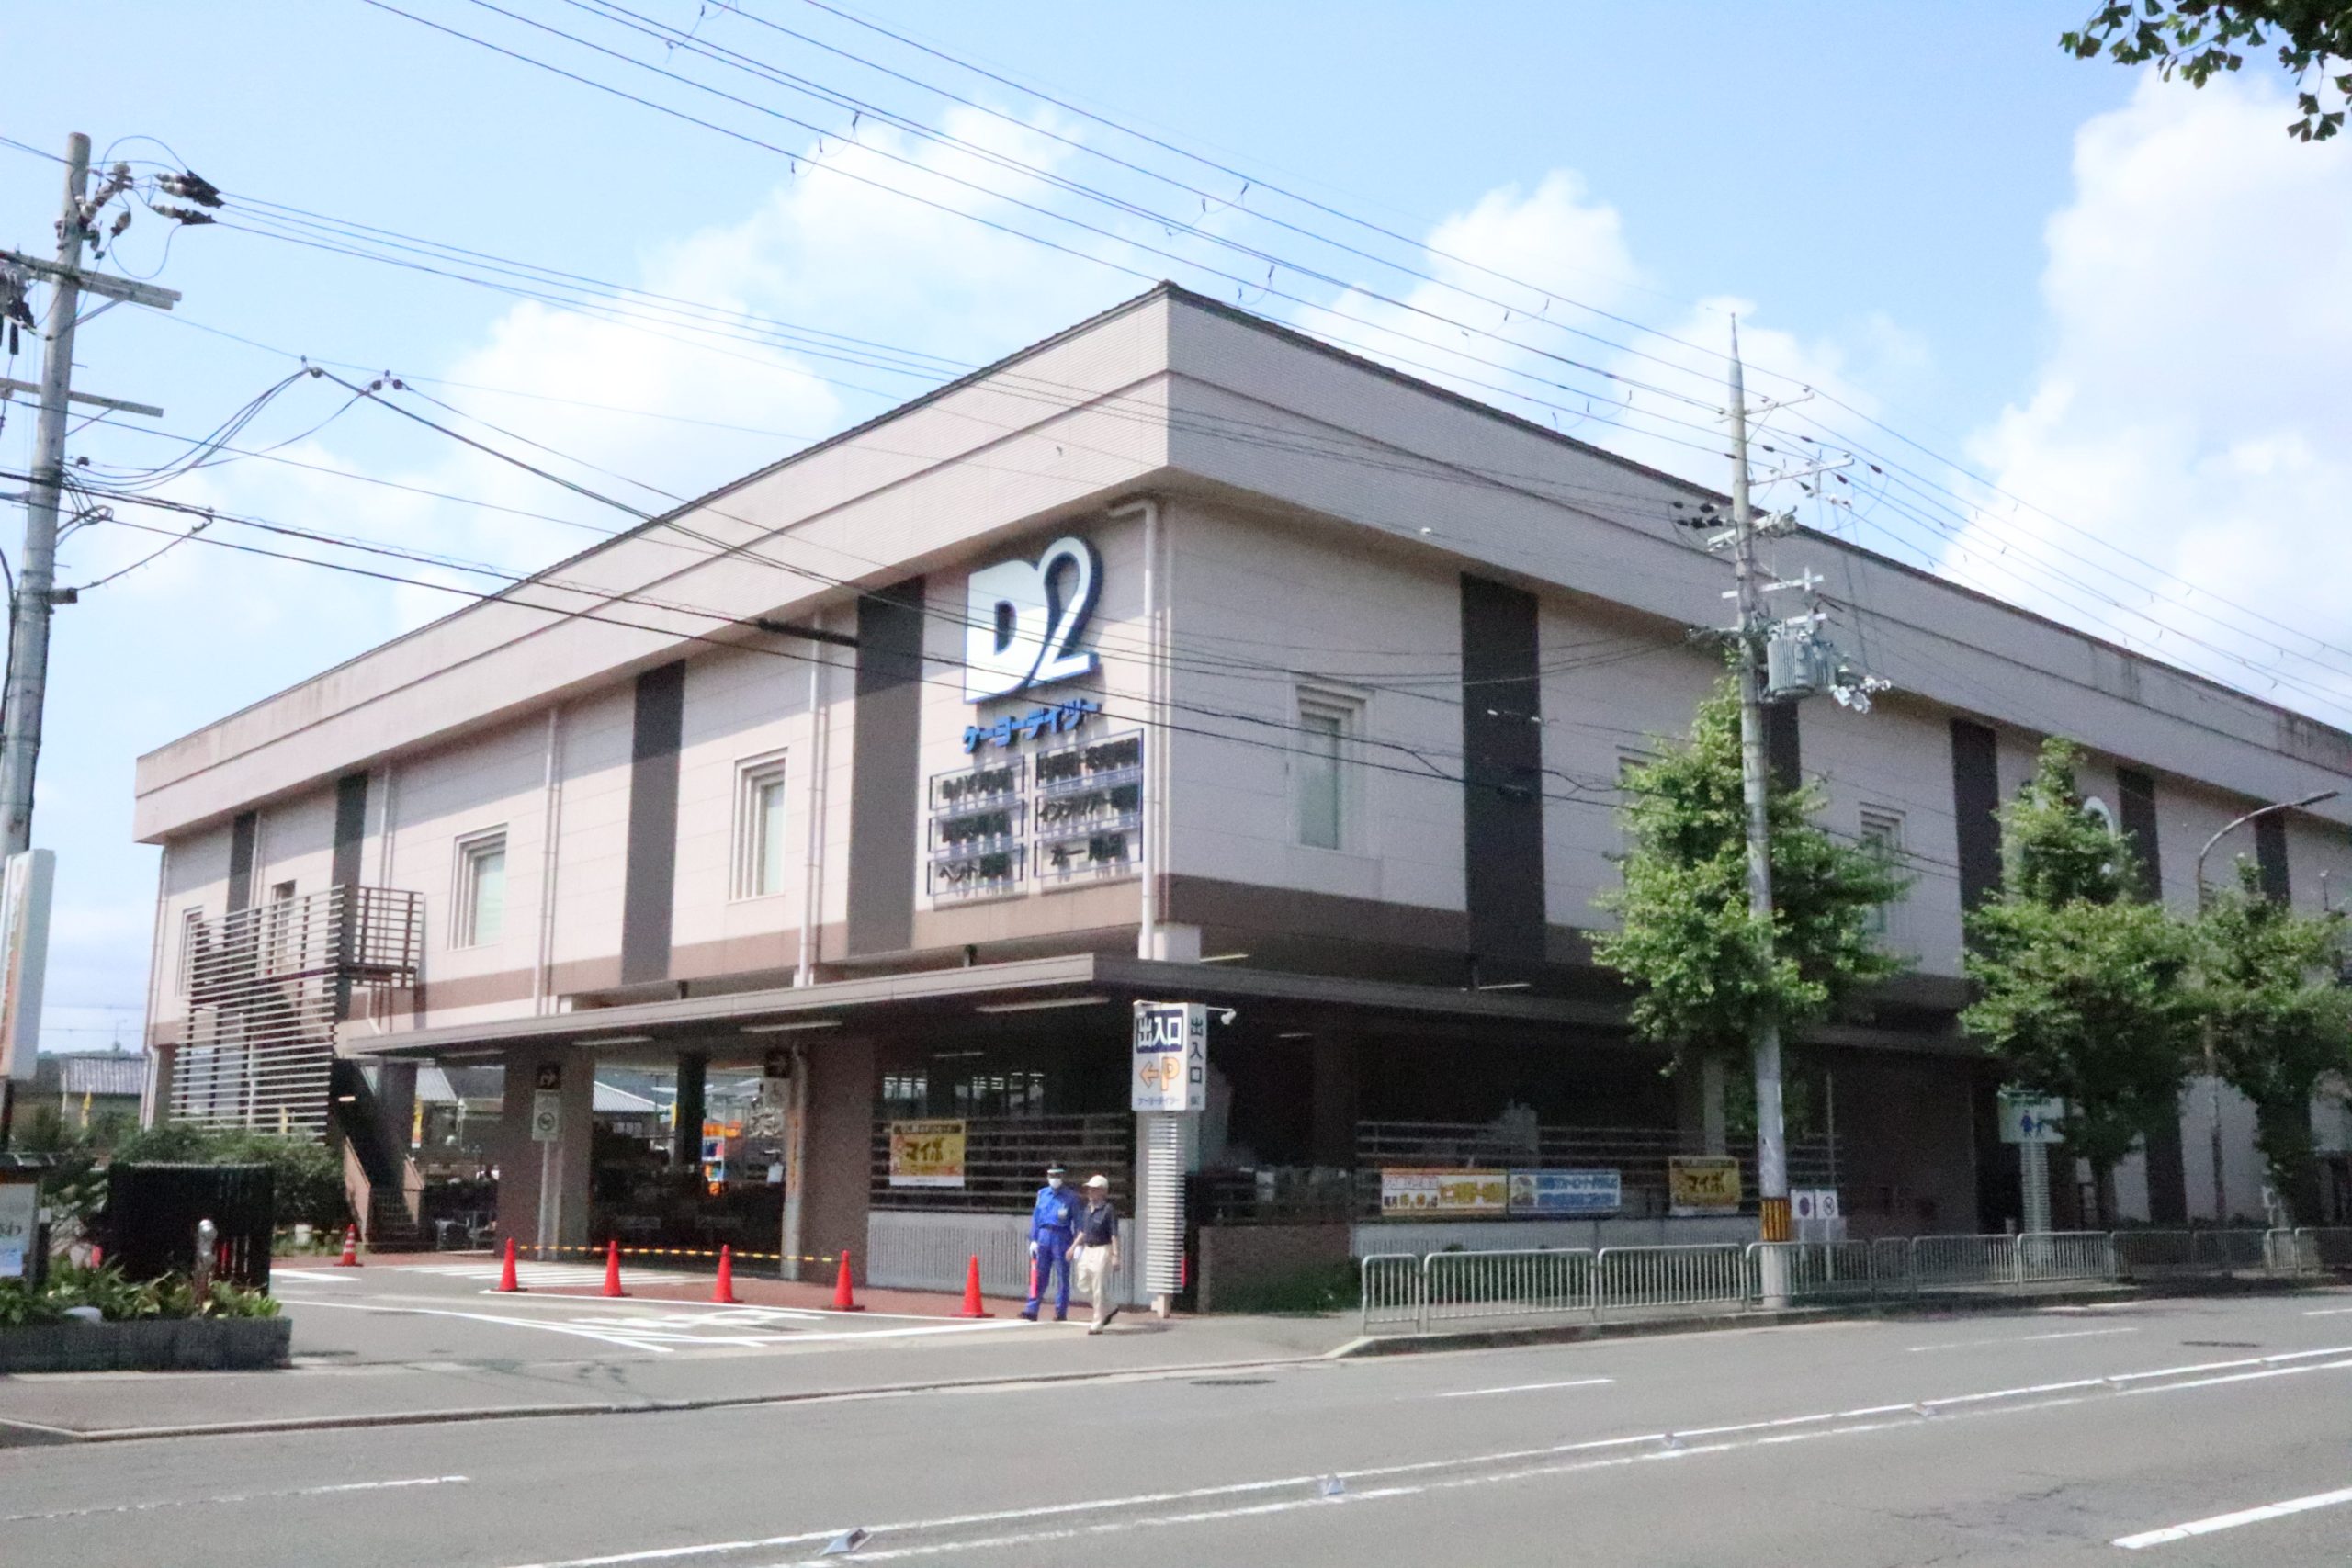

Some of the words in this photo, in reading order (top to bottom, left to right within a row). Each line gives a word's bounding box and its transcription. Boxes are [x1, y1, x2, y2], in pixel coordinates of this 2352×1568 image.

[964, 536, 1101, 705] D2
[1137, 1016, 1182, 1047] 出入口
[1190, 1017, 1204, 1084] 出入口
[1161, 1057, 1180, 1091] P
